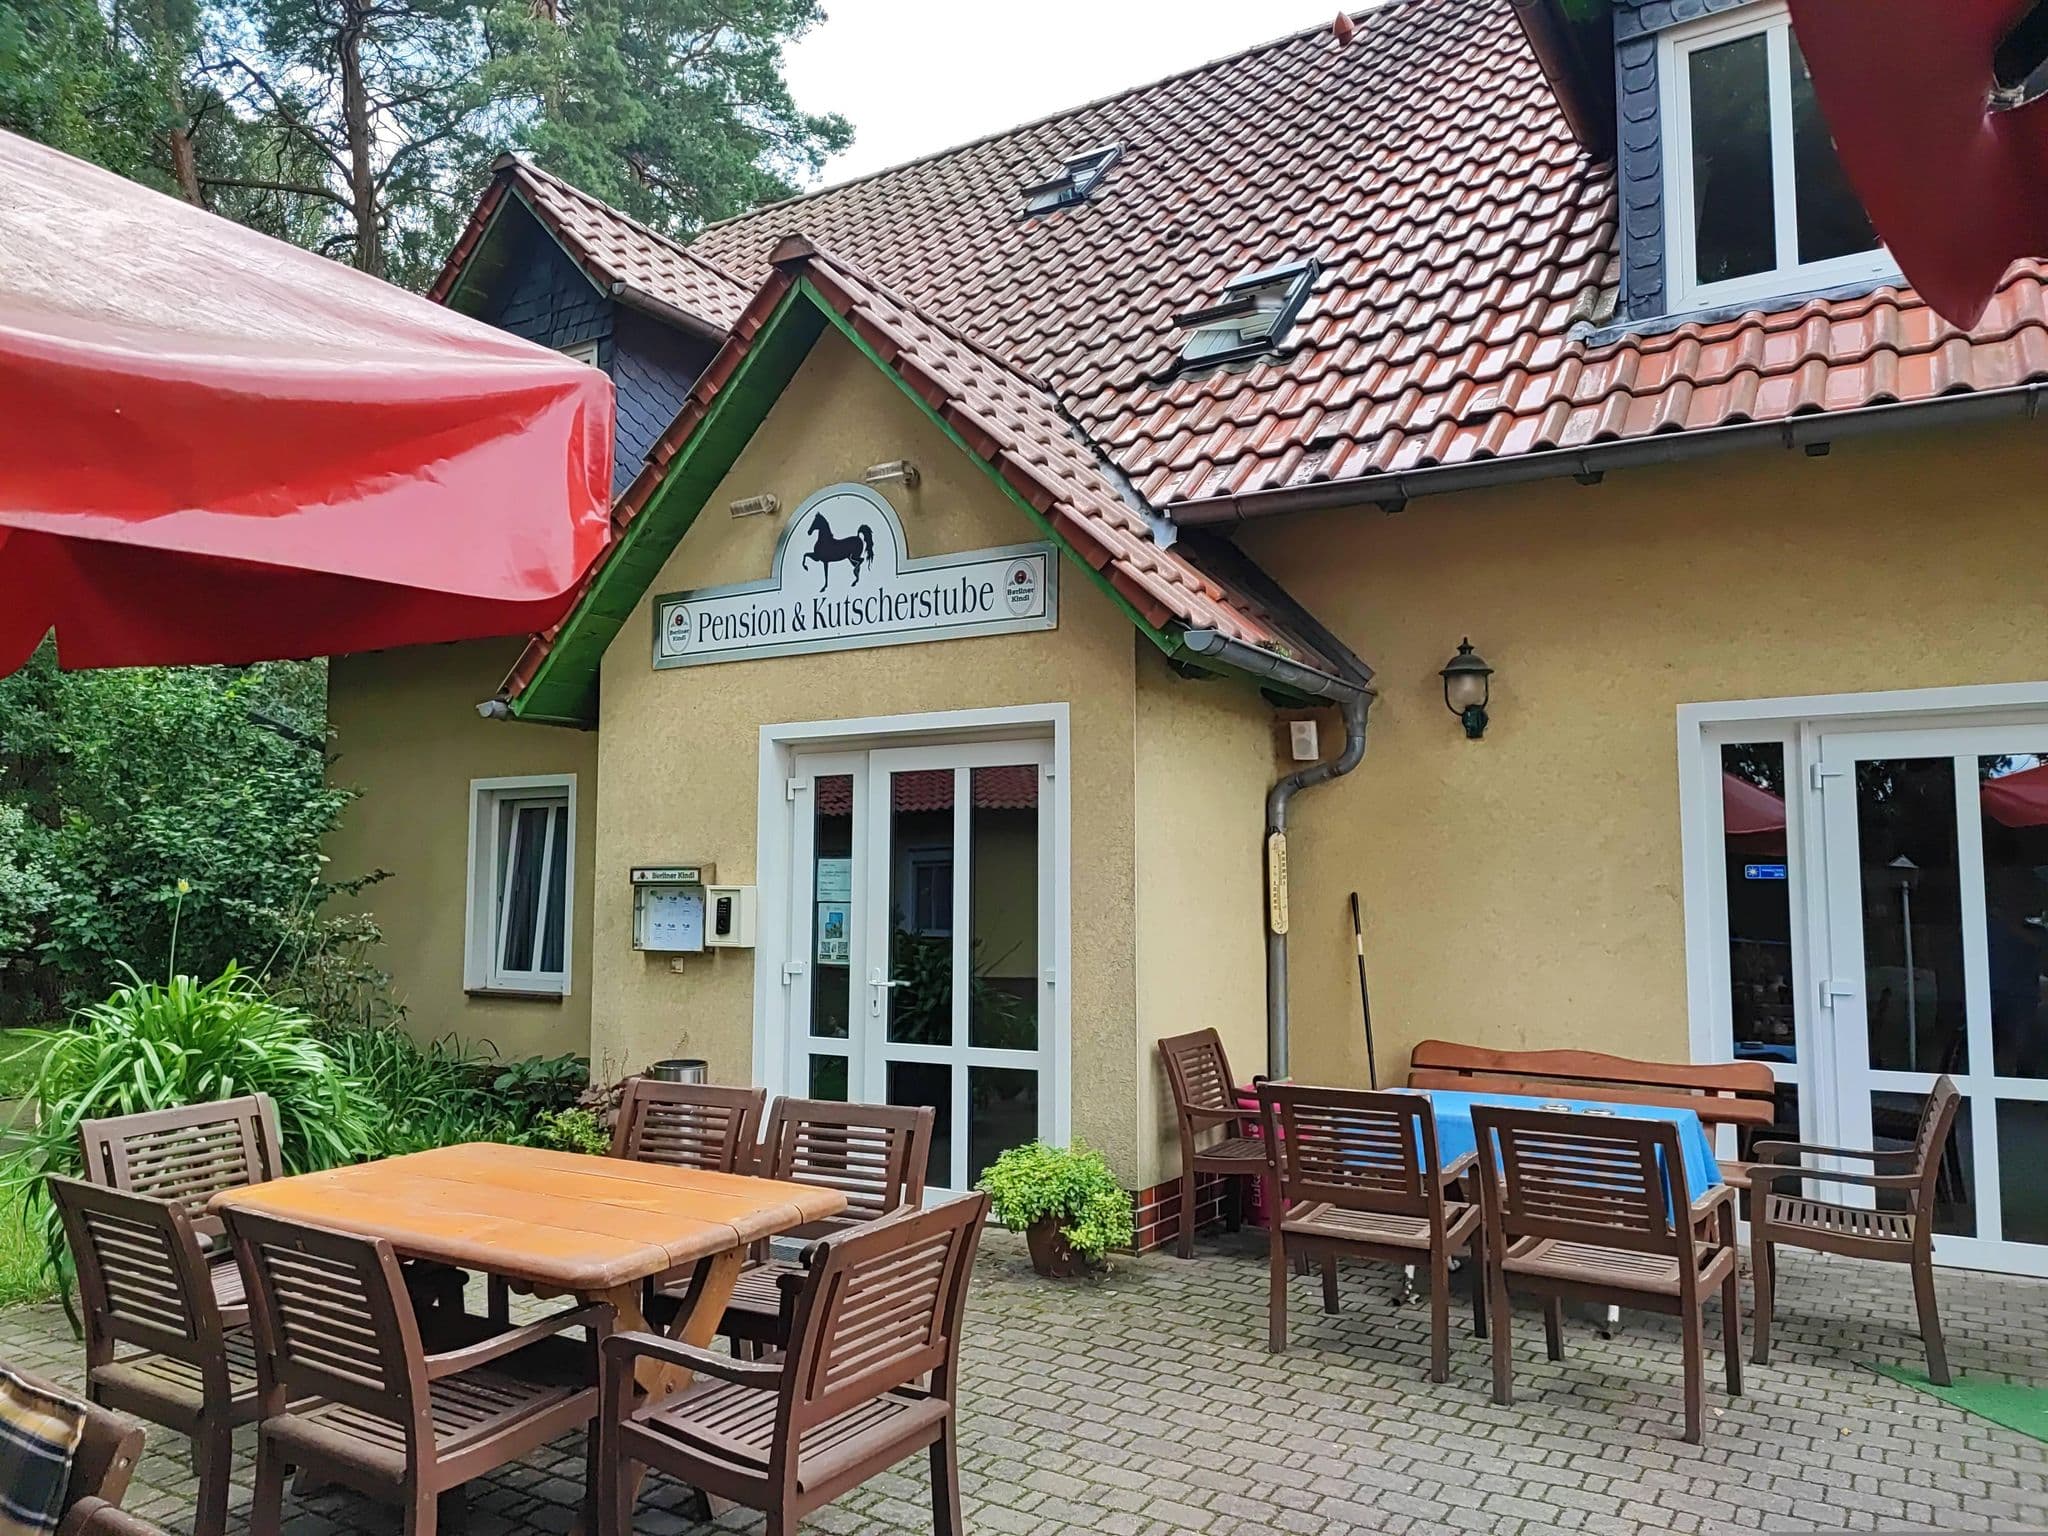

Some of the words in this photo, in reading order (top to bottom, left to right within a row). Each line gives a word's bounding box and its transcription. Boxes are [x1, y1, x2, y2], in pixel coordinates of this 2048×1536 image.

[1007, 588, 1034, 596] Berliner
[698, 604, 786, 643] Pension
[792, 602, 806, 632] &
[813, 576, 994, 630] Kutscherstube
[669, 628, 690, 636] Berliner
[651, 871, 677, 879] Berliner
[677, 871, 695, 879] Kindl
